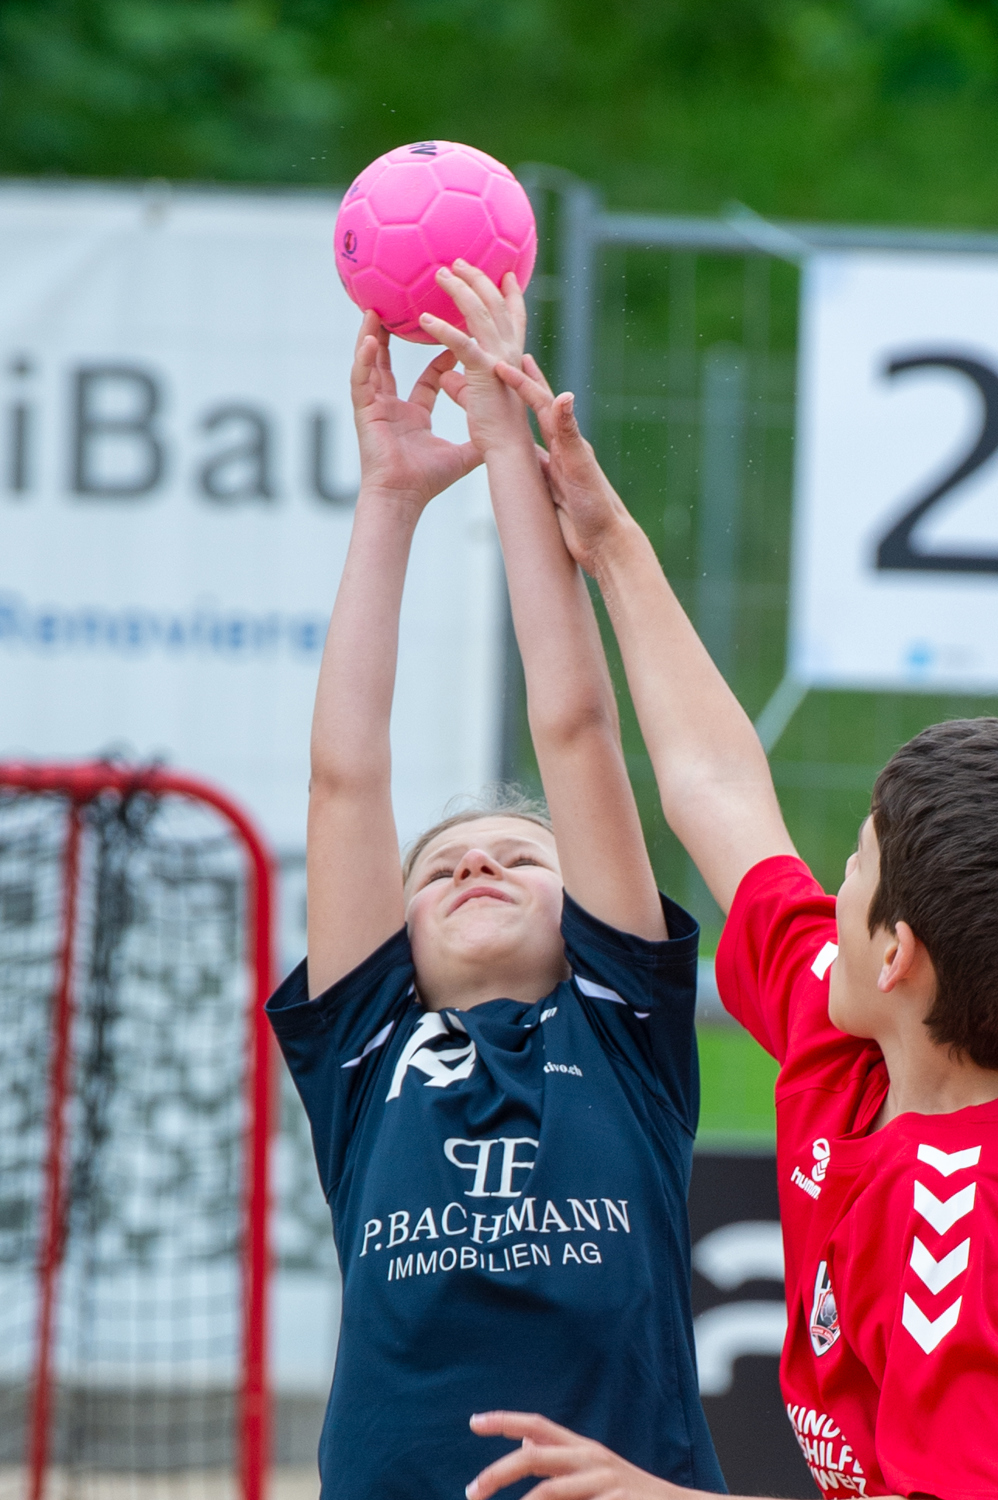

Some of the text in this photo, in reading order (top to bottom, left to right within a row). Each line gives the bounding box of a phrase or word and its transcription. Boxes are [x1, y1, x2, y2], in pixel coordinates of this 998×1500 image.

[790, 1166, 822, 1201] humm
[359, 1197, 631, 1257] P.BACHMANN
[387, 1242, 602, 1281] IMMOBILIEN AG
